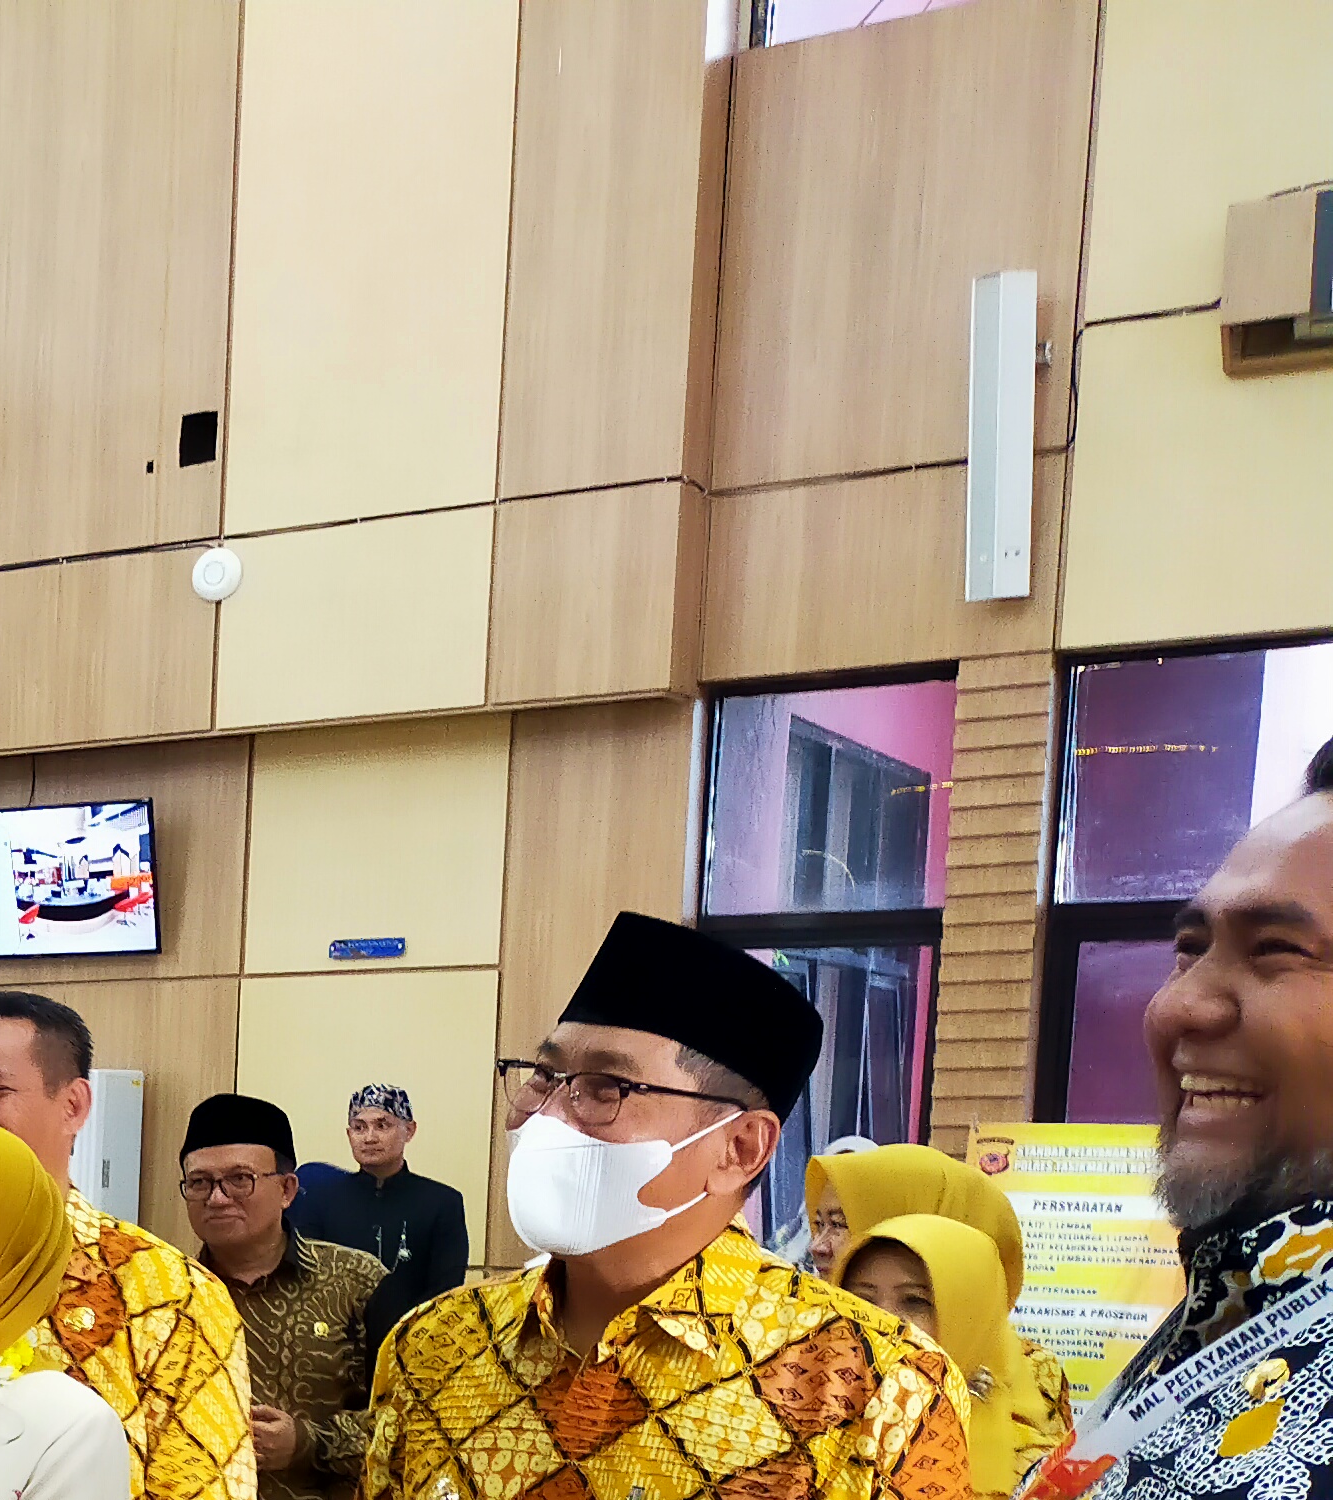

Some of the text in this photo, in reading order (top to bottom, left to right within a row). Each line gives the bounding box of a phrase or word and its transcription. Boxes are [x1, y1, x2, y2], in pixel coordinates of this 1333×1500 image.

[1033, 1199, 1123, 1213] PERSYARATAN
[1128, 1279, 1333, 1422] MAL PELAYANAN PUBLIK
[1174, 1327, 1290, 1404] KOTA TASIKMALAYA
